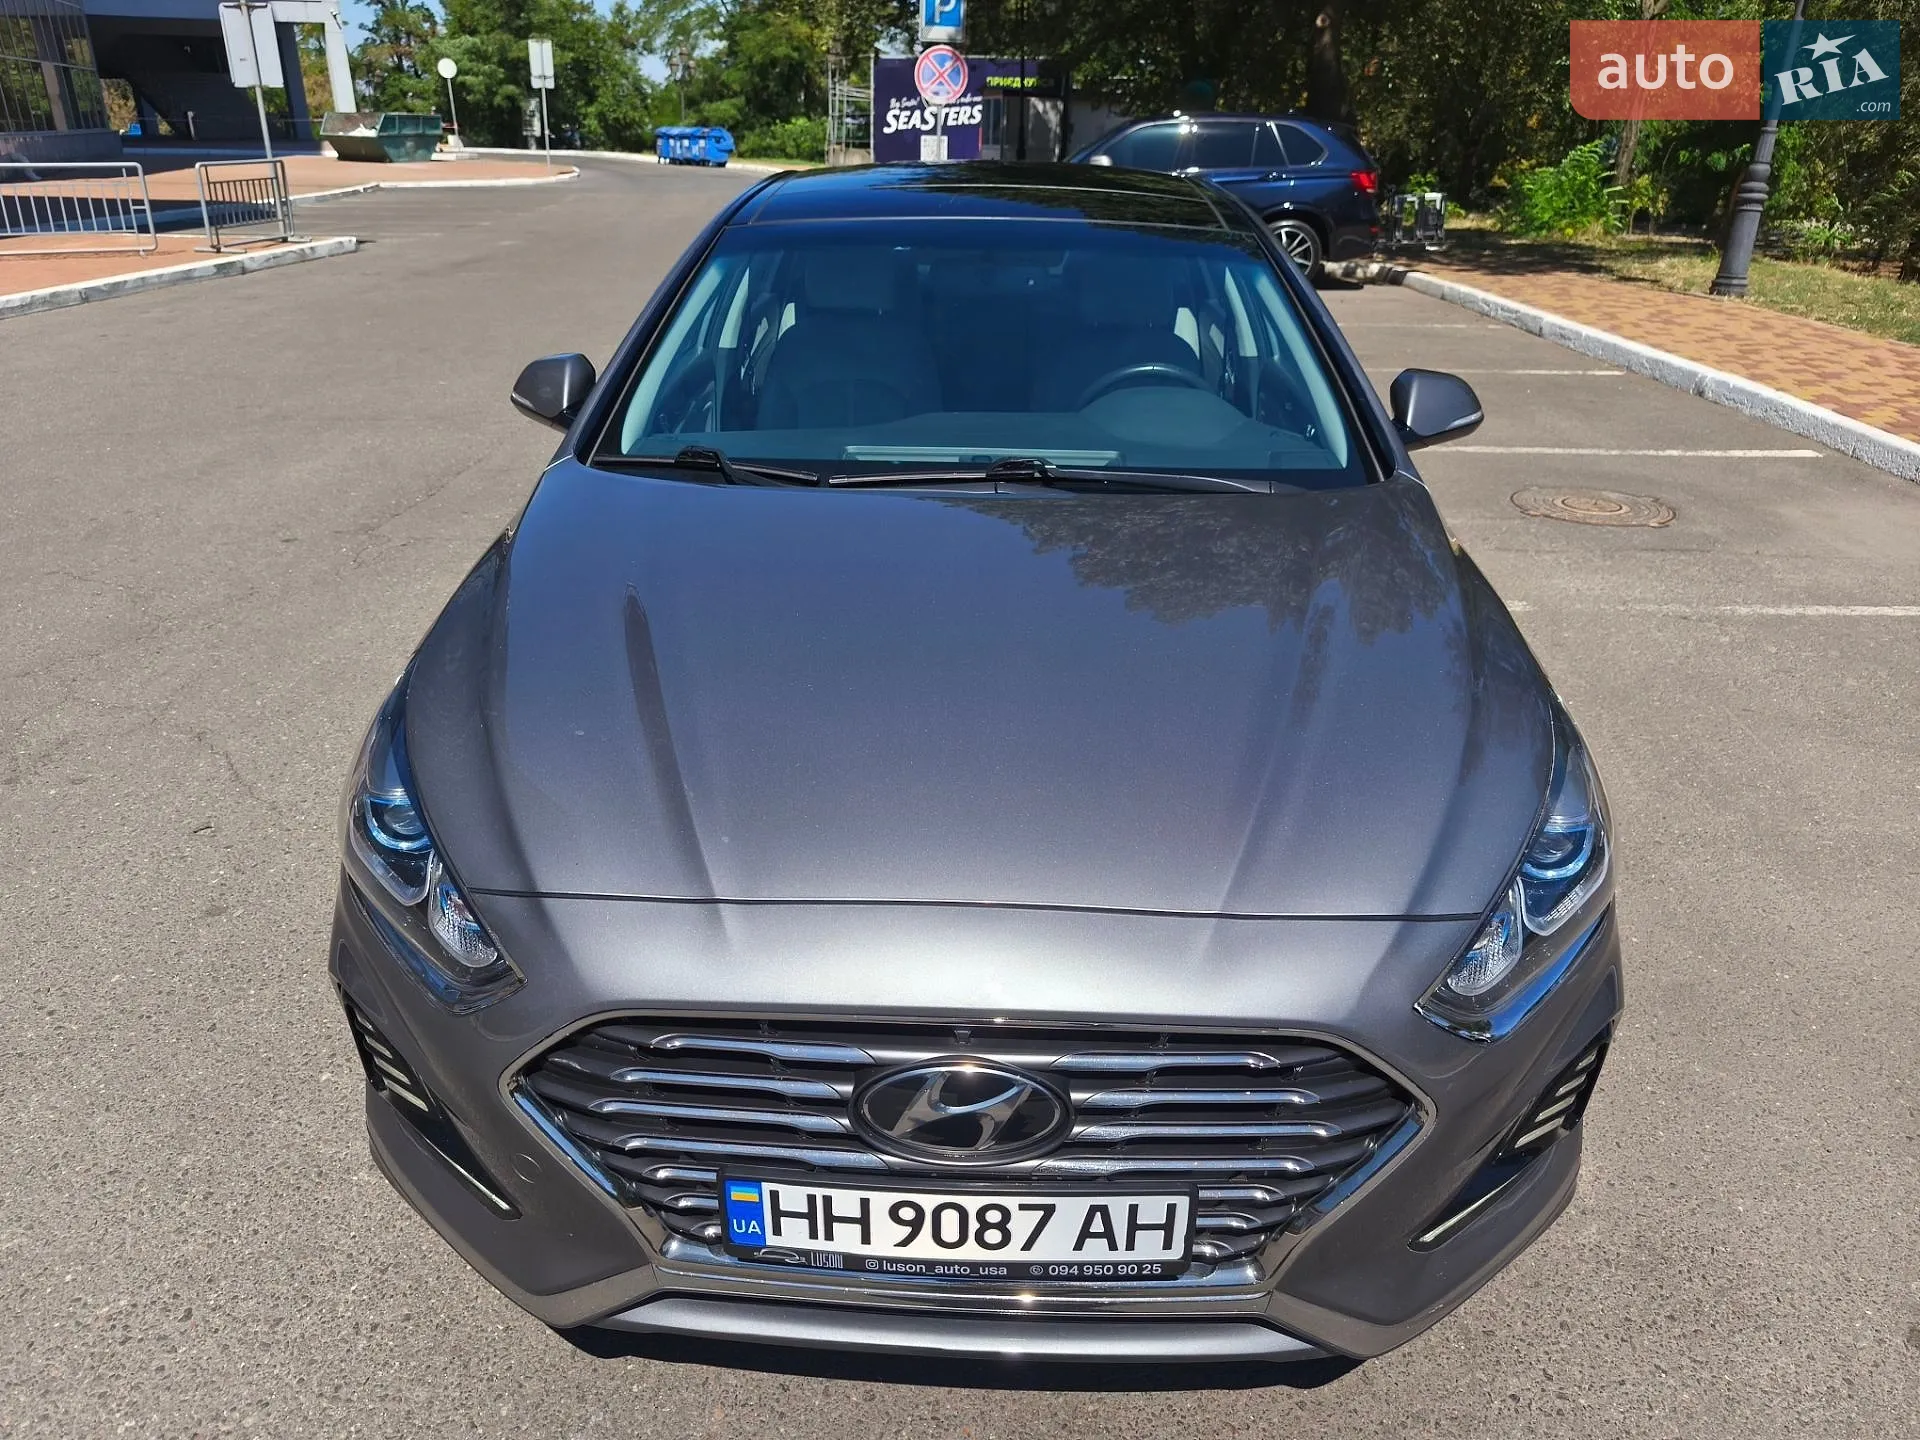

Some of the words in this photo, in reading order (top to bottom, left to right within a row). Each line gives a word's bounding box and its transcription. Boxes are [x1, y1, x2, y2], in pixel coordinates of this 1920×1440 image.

[883, 104, 983, 134] SEASTERS
[733, 1219, 761, 1235] UA
[769, 1189, 871, 1245] HH
[888, 1199, 1056, 1251] 9087
[1072, 1203, 1177, 1251] AH
[883, 1260, 1007, 1276] luson_auto_usa
[1048, 1264, 1079, 1276] 094
[1083, 1264, 1113, 1276] 950
[1118, 1264, 1138, 1275] 90
[1142, 1263, 1162, 1275] 25
